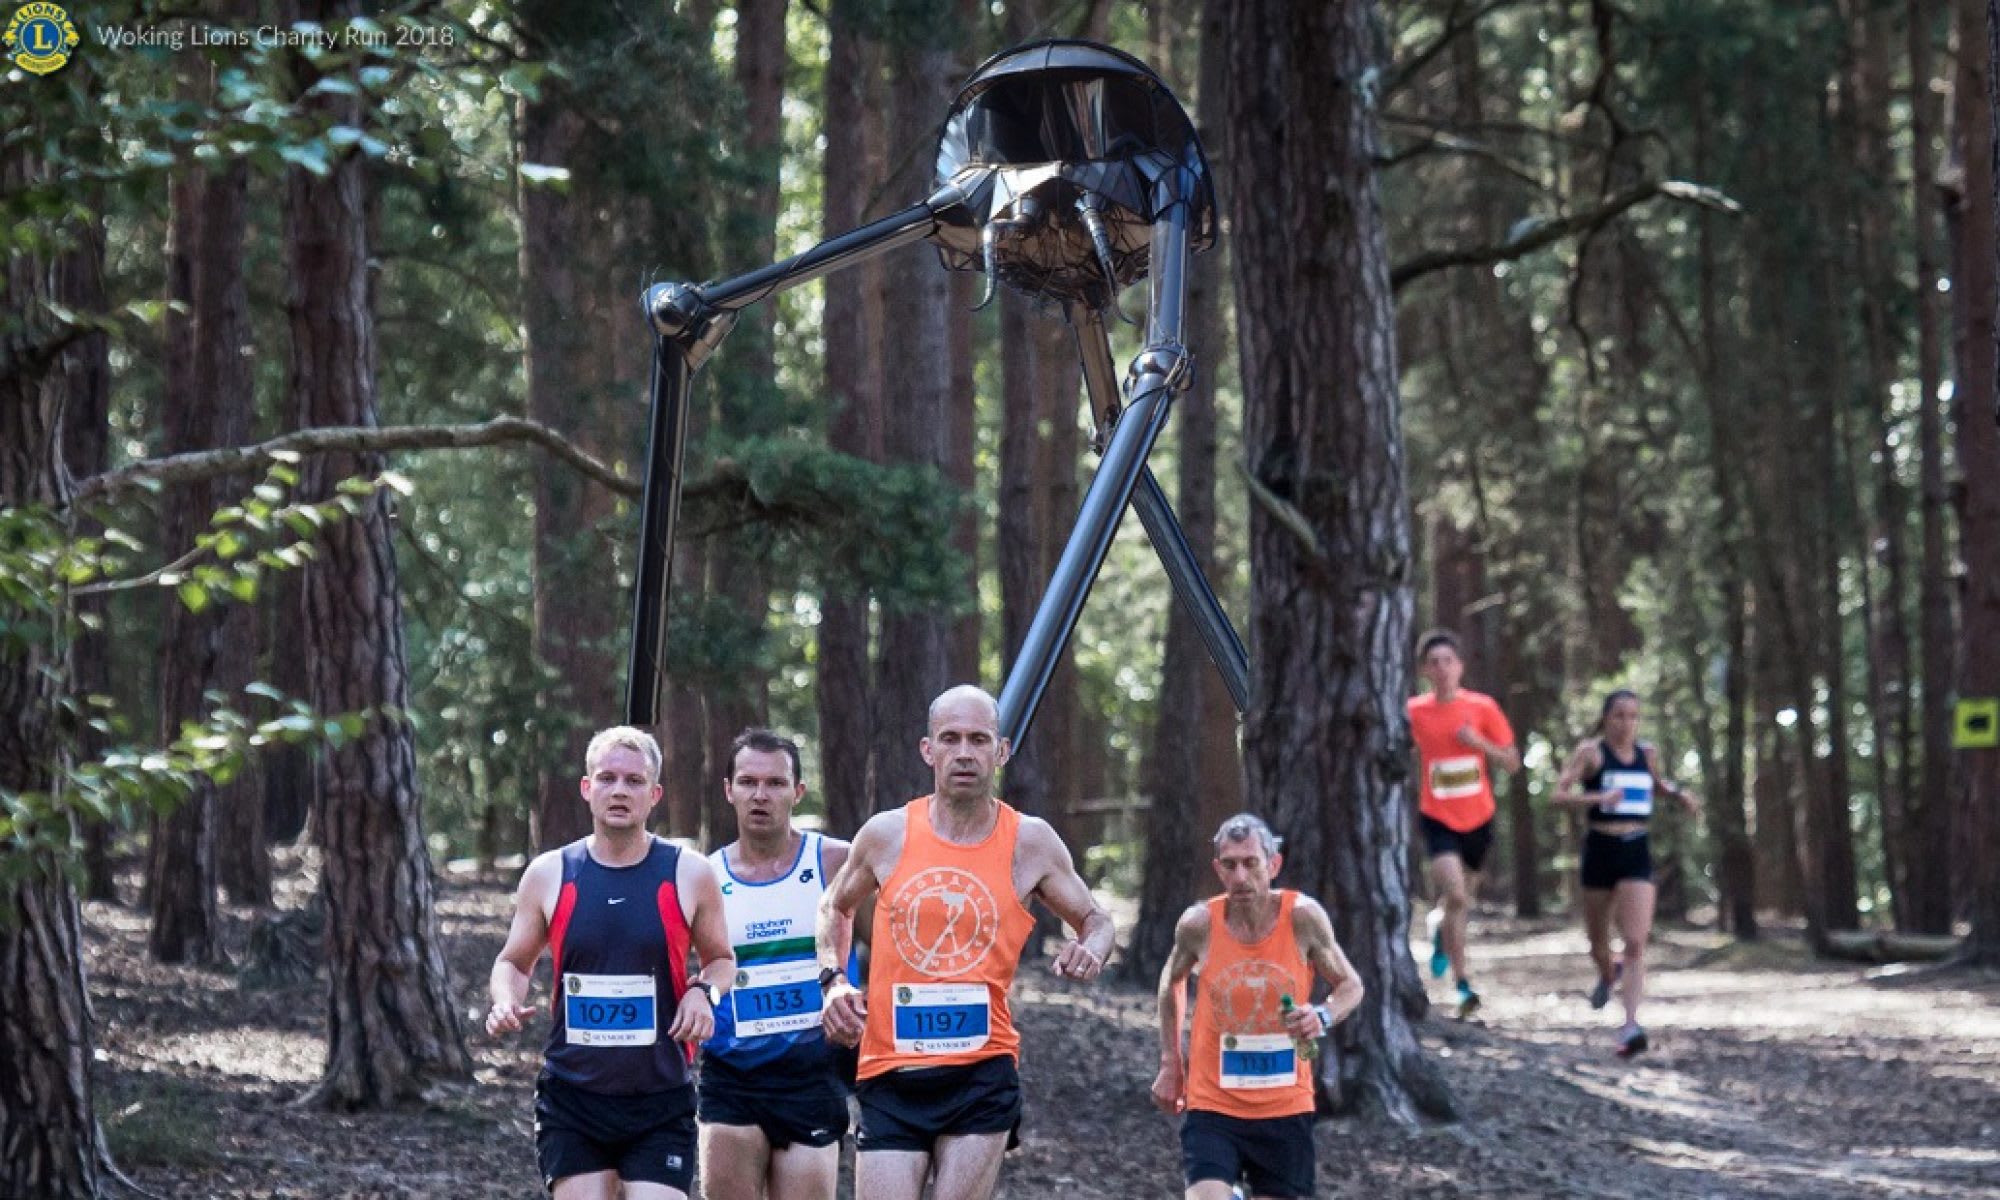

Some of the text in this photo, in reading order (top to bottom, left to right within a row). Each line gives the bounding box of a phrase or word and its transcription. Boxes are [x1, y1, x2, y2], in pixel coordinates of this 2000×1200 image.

[753, 988, 804, 1012] 1133
[579, 1003, 638, 1024] 1079
[914, 1011, 968, 1033] 1197
